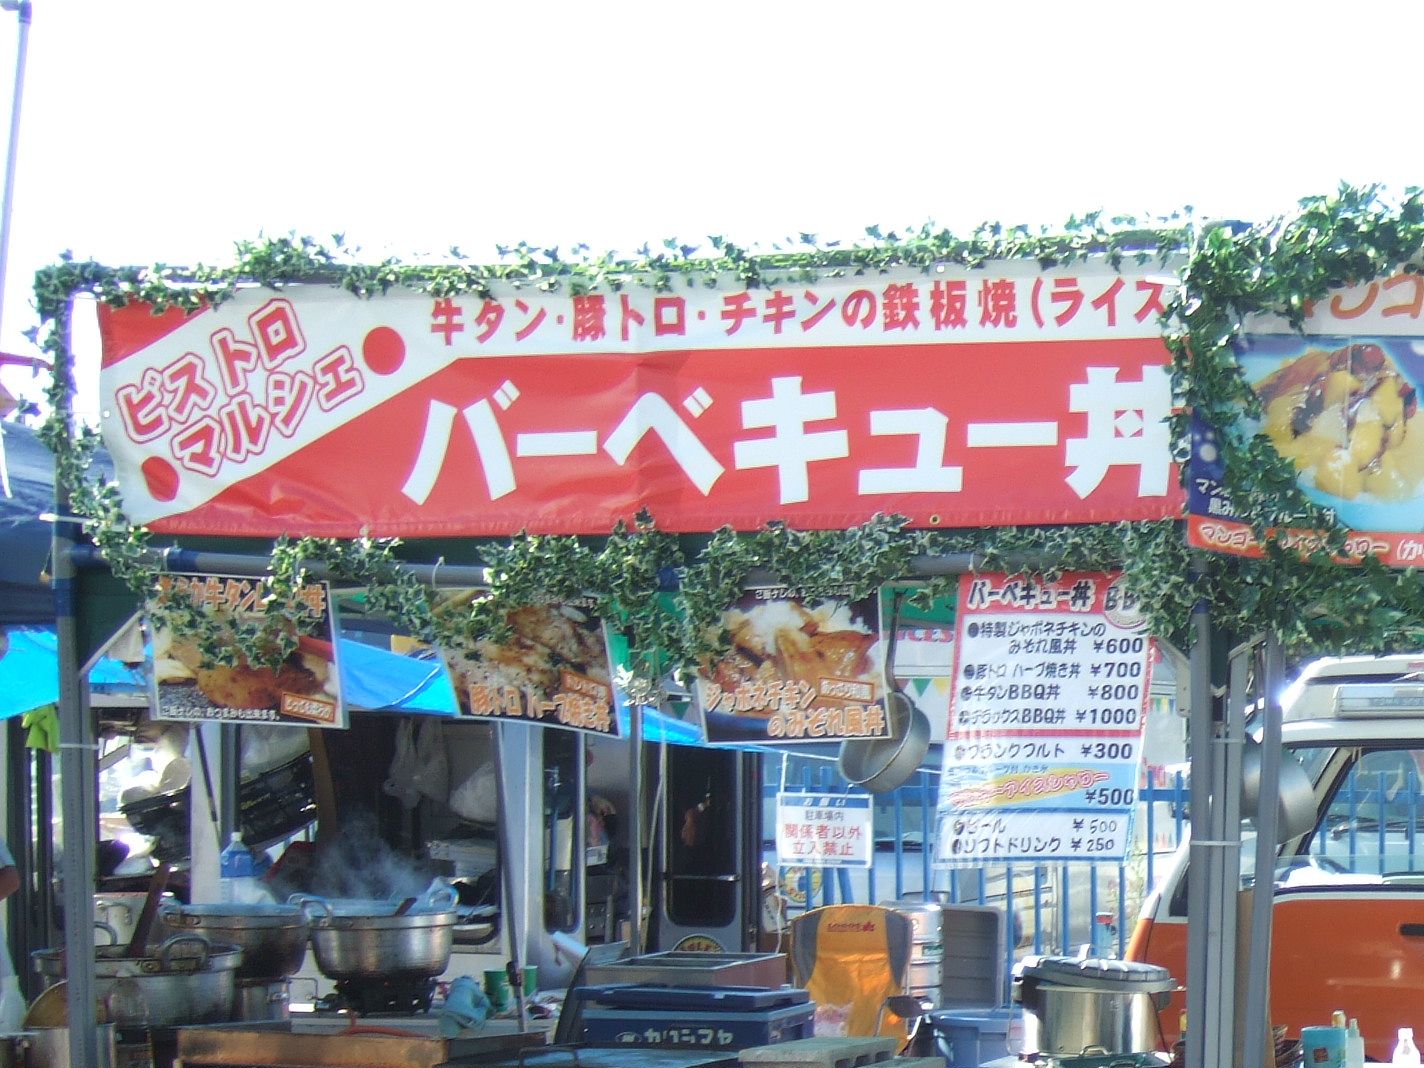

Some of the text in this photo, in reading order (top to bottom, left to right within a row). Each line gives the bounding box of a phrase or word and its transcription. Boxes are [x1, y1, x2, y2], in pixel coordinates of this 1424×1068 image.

[117, 298, 304, 444] ビストロ
[172, 345, 364, 476] マルシェ
[401, 364, 1176, 506] バーベキュー丼
[967, 580, 1095, 611] バーベキュー丼
[1093, 637, 1143, 654] ¥600
[1090, 662, 1141, 679] ¥700
[1088, 684, 1140, 700] ¥800
[1075, 708, 1136, 725] ¥1000
[1080, 743, 1133, 760] ¥300
[1085, 788, 1133, 805] ¥500
[784, 823, 862, 840] 関係者以外
[793, 840, 855, 856] 立入禁止
